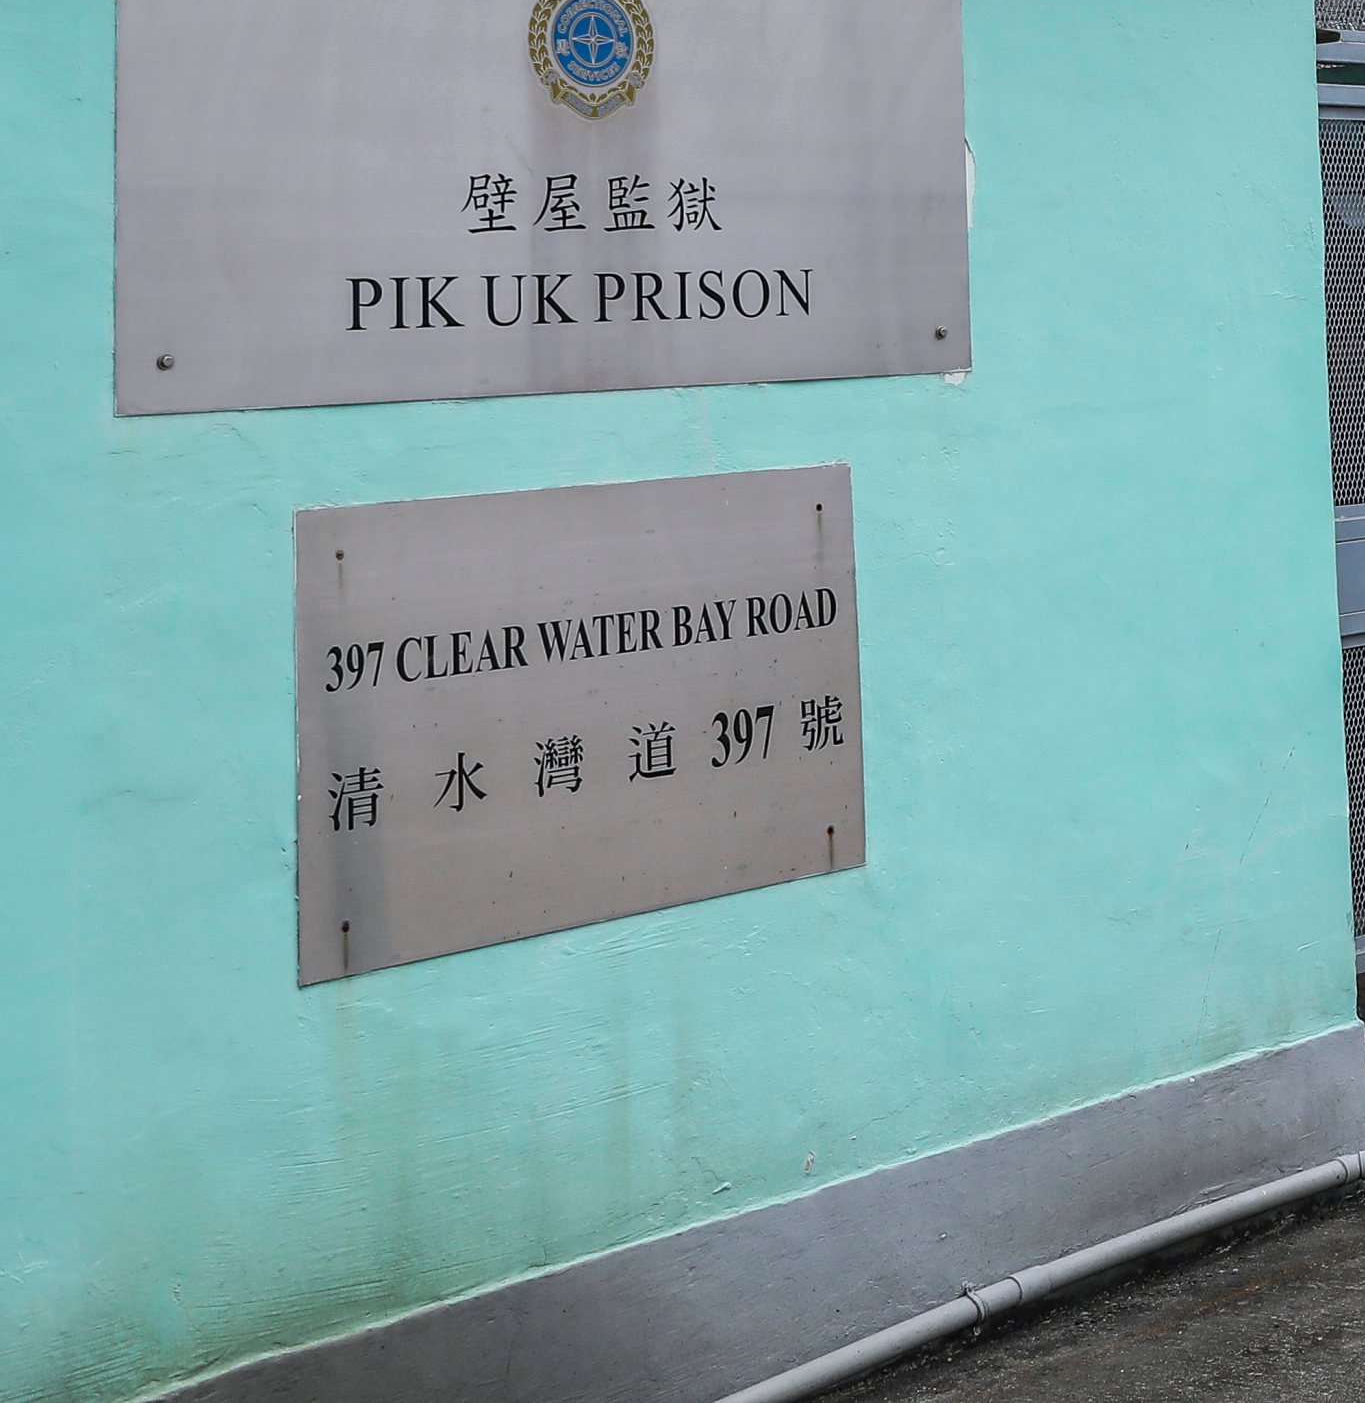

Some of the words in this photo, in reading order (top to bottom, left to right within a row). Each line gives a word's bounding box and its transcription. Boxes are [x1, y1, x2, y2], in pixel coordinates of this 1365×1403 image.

[567, 58, 620, 82] SERVICES
[460, 173, 723, 234] 壁屋監獄
[345, 276, 466, 331] PIK
[480, 273, 579, 327] UK
[593, 269, 814, 323] PRISON
[325, 641, 385, 694] 397
[396, 625, 529, 683] CLEAR
[537, 609, 664, 662] WATER
[671, 599, 737, 647] BAY
[745, 587, 837, 638] ROAD
[327, 721, 678, 832] 清水灣道
[711, 704, 775, 768] 397
[800, 695, 845, 752] 號
